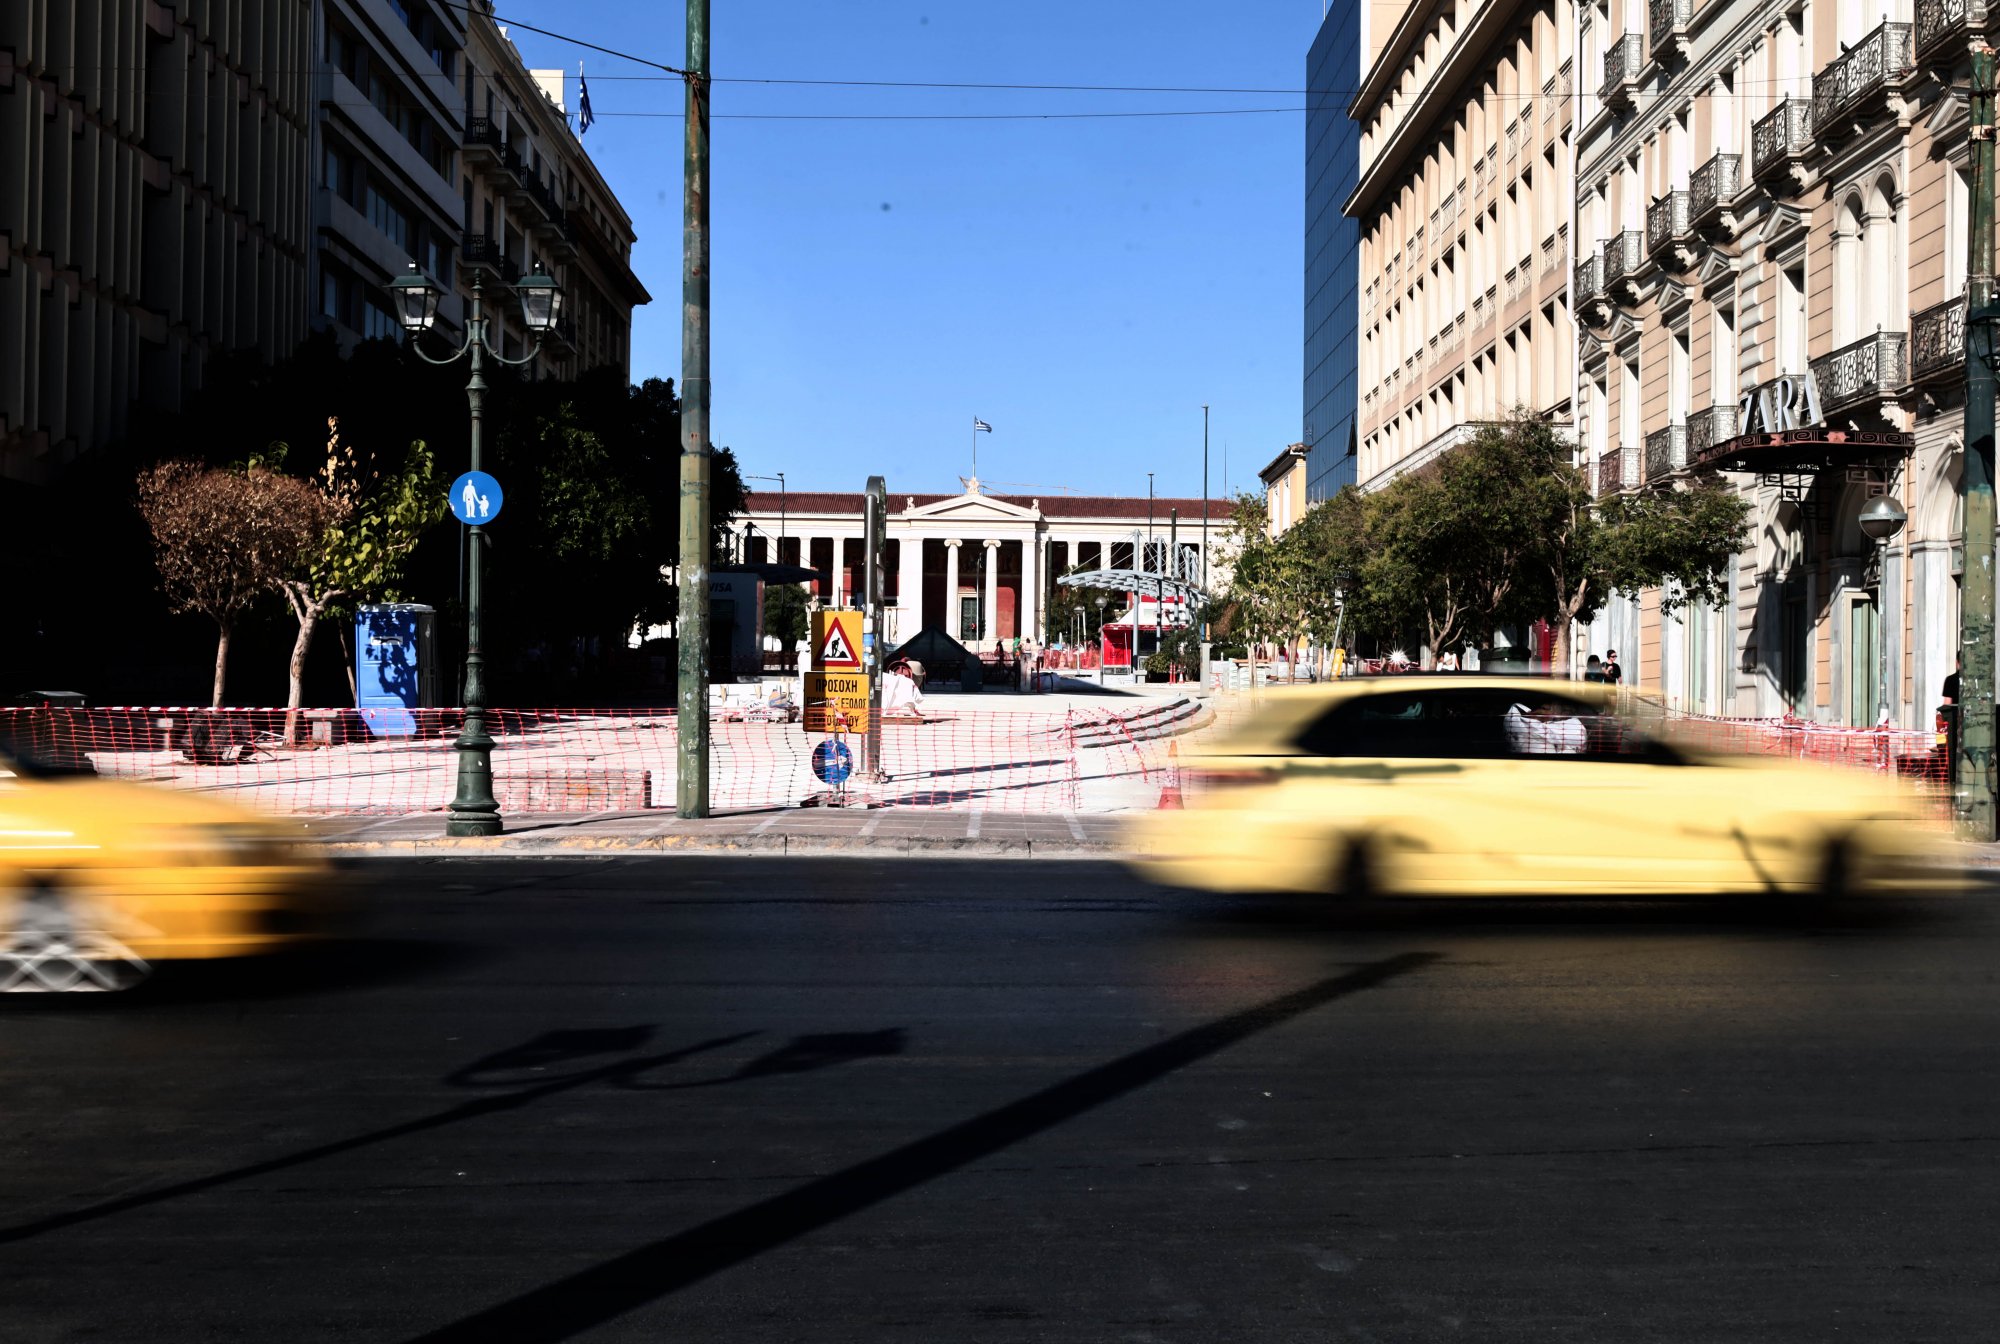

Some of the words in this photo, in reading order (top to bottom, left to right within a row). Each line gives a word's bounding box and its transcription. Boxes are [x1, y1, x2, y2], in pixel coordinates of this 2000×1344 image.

[1739, 367, 1824, 435] ZARA
[815, 679, 858, 693] ΠΡΟΣΟΧΗ
[841, 697, 867, 709] ΕΞΟΔΟΣ
